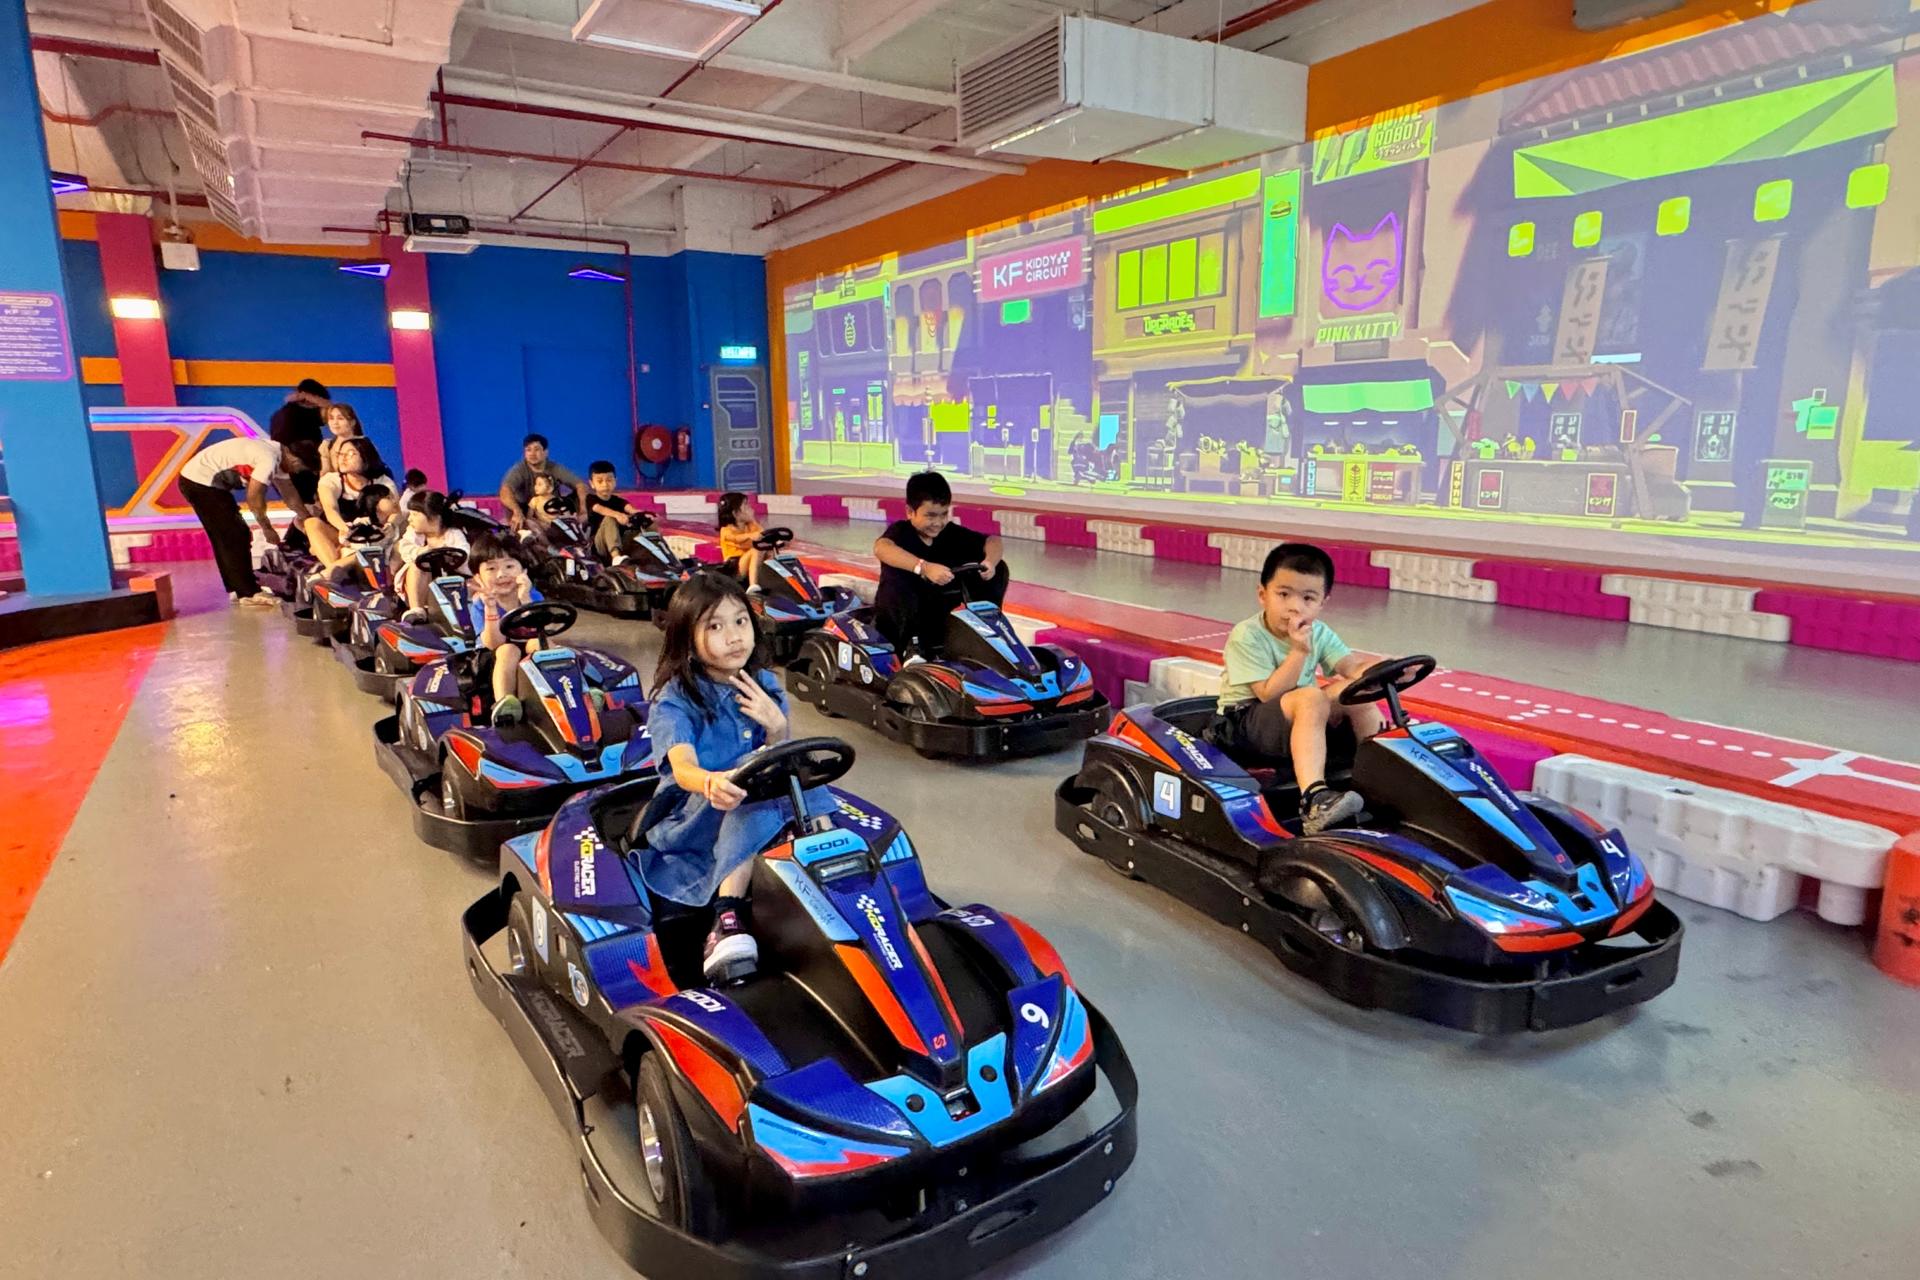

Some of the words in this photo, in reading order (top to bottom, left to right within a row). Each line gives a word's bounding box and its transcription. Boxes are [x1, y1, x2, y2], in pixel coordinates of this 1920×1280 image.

[993, 261, 1023, 289] KF
[1025, 253, 1057, 271] KIDDY
[1025, 264, 1069, 283] CIRCUIT
[1316, 326, 1353, 344] PINK
[1355, 321, 1402, 341] KITTY
[841, 648, 848, 664] 6
[1064, 659, 1075, 670] 6
[638, 725, 651, 738] 2
[1160, 781, 1174, 810] 4
[806, 837, 850, 854] SODI
[1600, 839, 1625, 858] 4
[1020, 1002, 1049, 1029] 9
